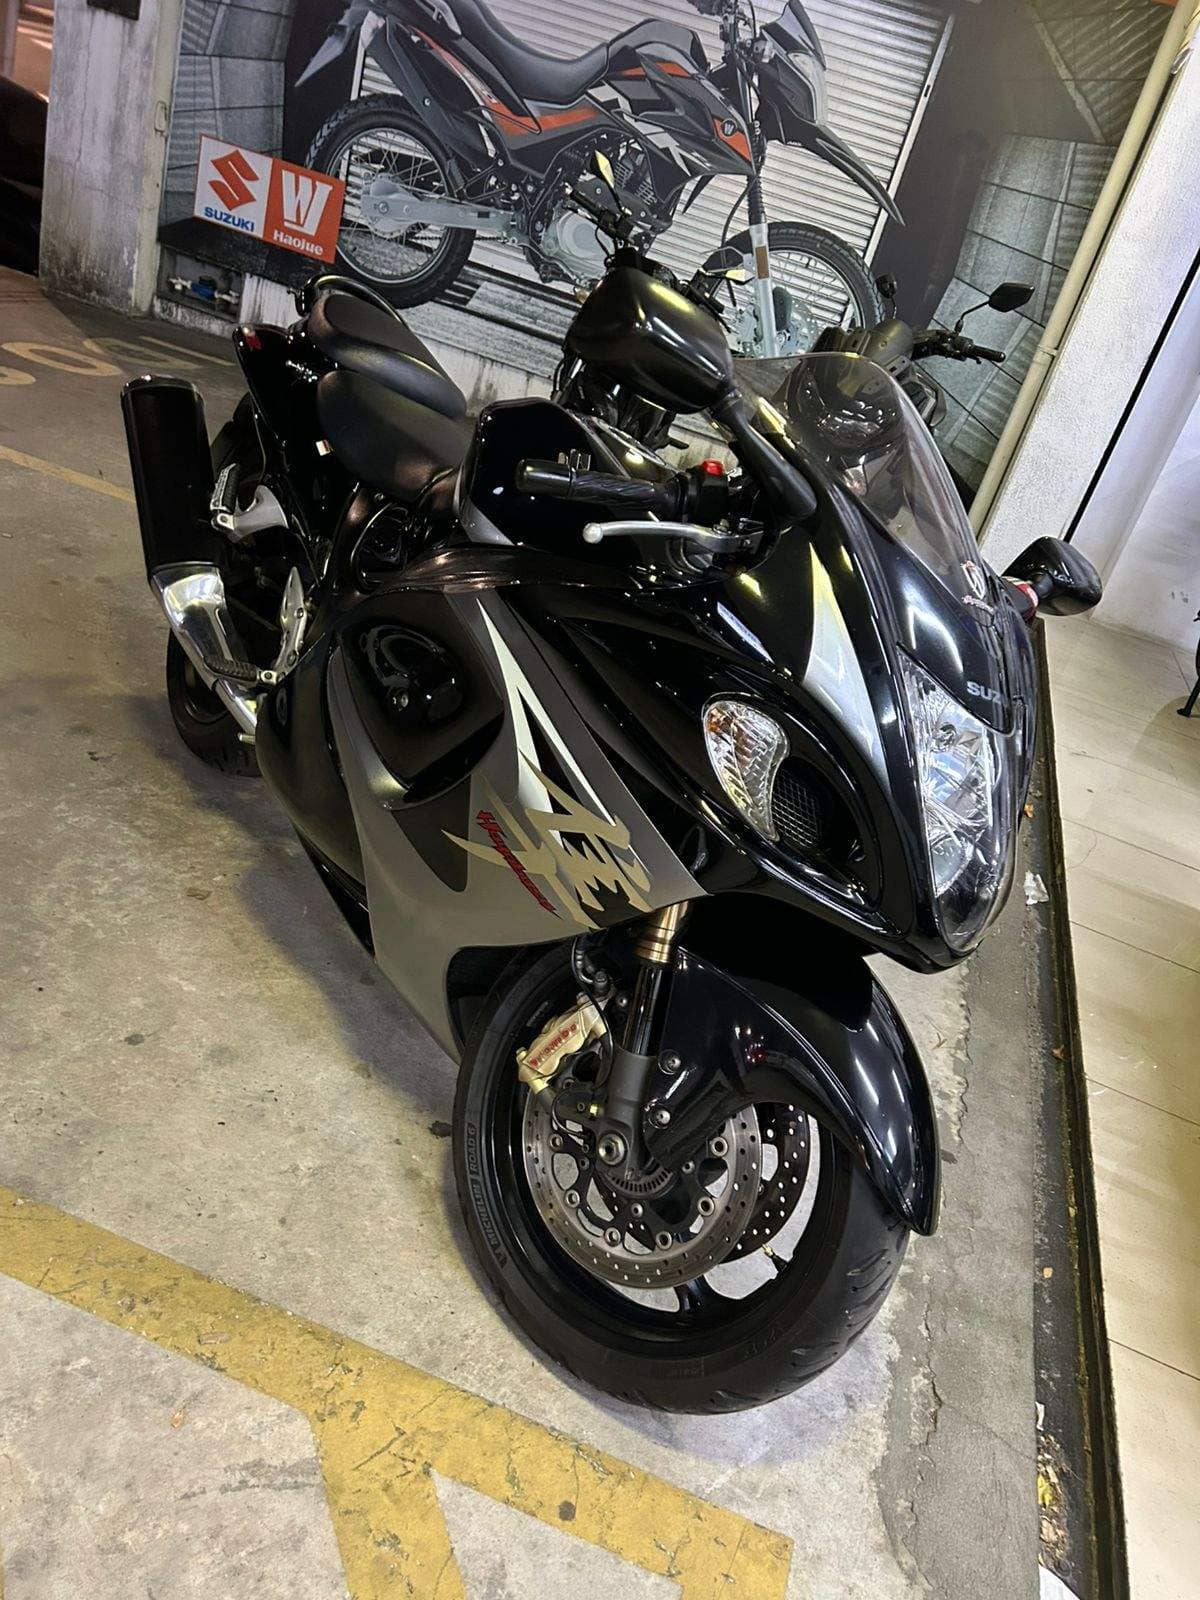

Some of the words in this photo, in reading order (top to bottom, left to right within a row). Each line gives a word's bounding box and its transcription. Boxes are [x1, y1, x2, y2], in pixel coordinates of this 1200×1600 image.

[203, 206, 255, 233] SUZUKI
[272, 229, 324, 256] Haojue
[467, 1137, 479, 1175] ROAD
[471, 1183, 499, 1247] MICHELIN
